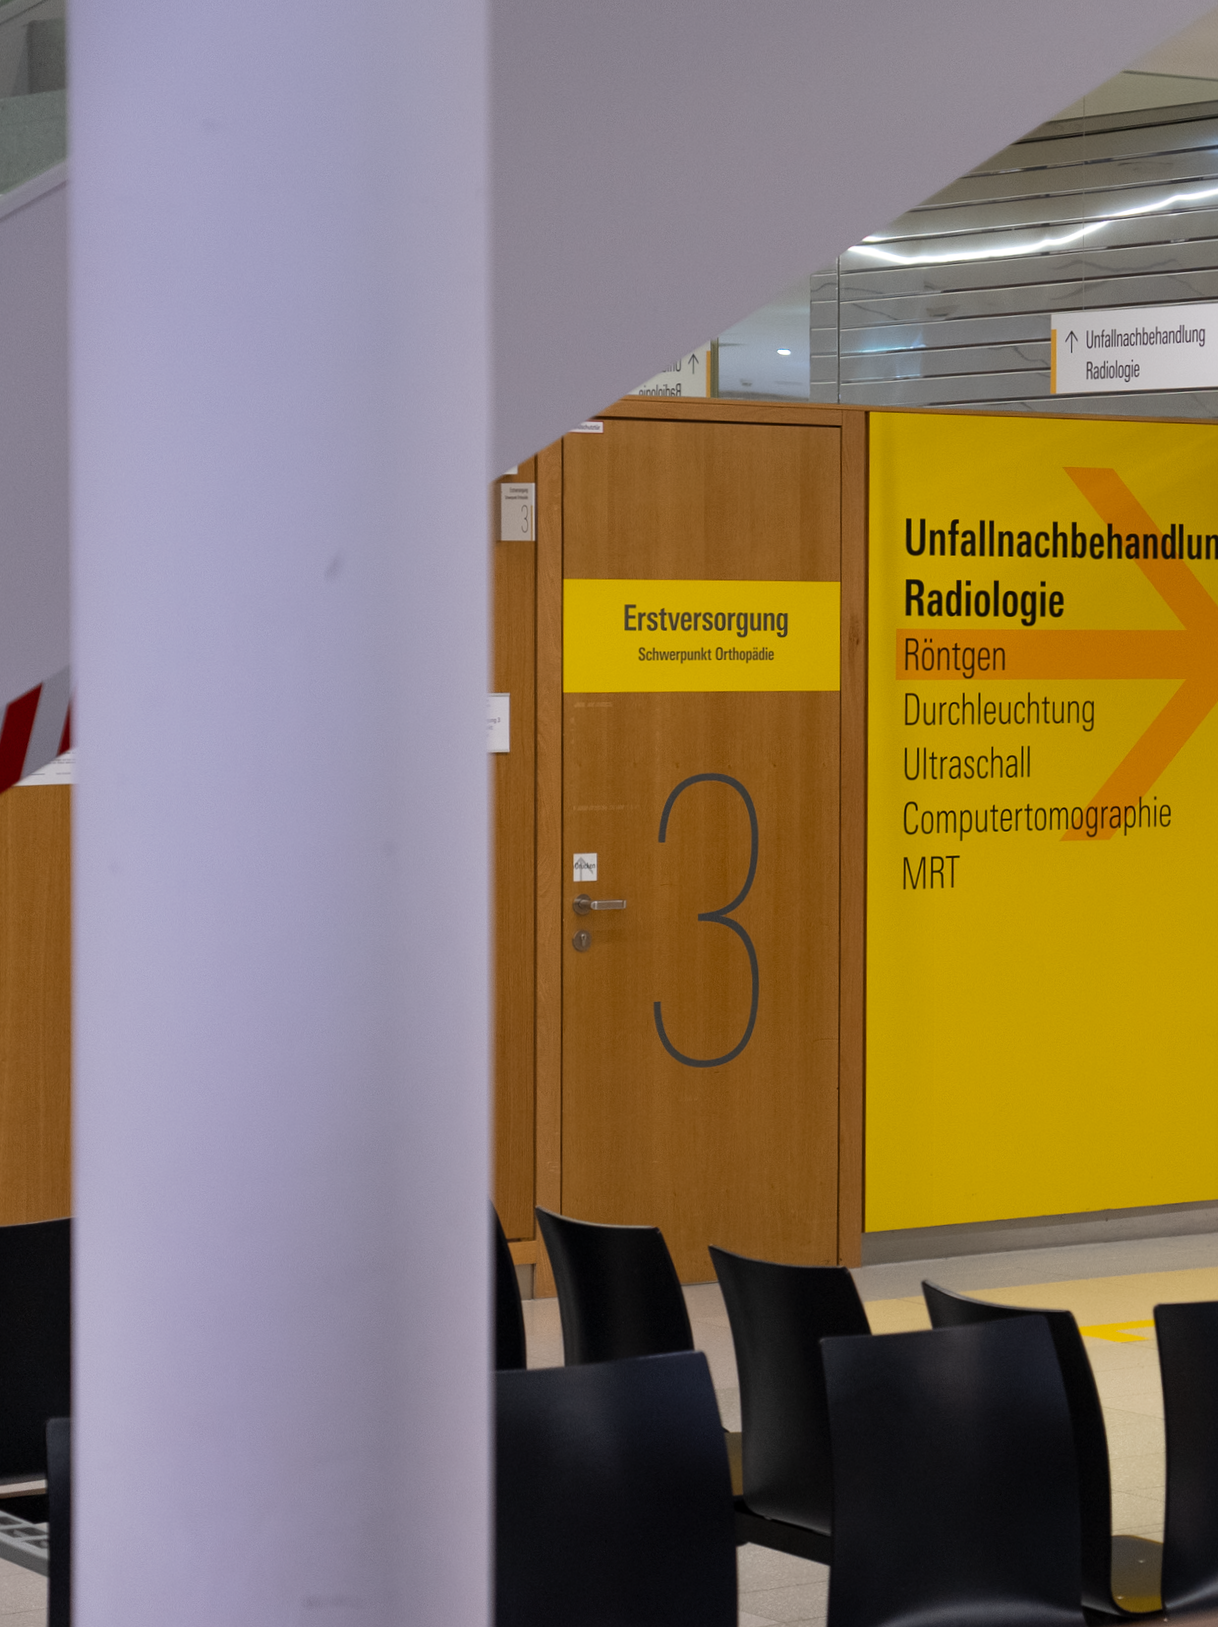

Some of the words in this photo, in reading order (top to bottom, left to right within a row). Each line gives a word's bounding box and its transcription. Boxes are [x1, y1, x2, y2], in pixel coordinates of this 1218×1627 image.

[1085, 324, 1206, 350] Unfallnachbehandlung
[1085, 359, 1140, 383] Radiologie
[520, 504, 529, 533] 3
[905, 578, 1065, 627] Radiologie
[623, 603, 789, 638] Erstversorgung
[638, 646, 712, 663] Schwerpunkt
[714, 646, 775, 664] Orthopädie
[904, 637, 1006, 679] Röntgen
[903, 691, 1096, 732] Durchleuchtung
[903, 745, 1031, 781] Ultraschall
[902, 796, 1172, 842] Computertomographie
[902, 855, 961, 890] MRT
[653, 772, 760, 1068] 3
